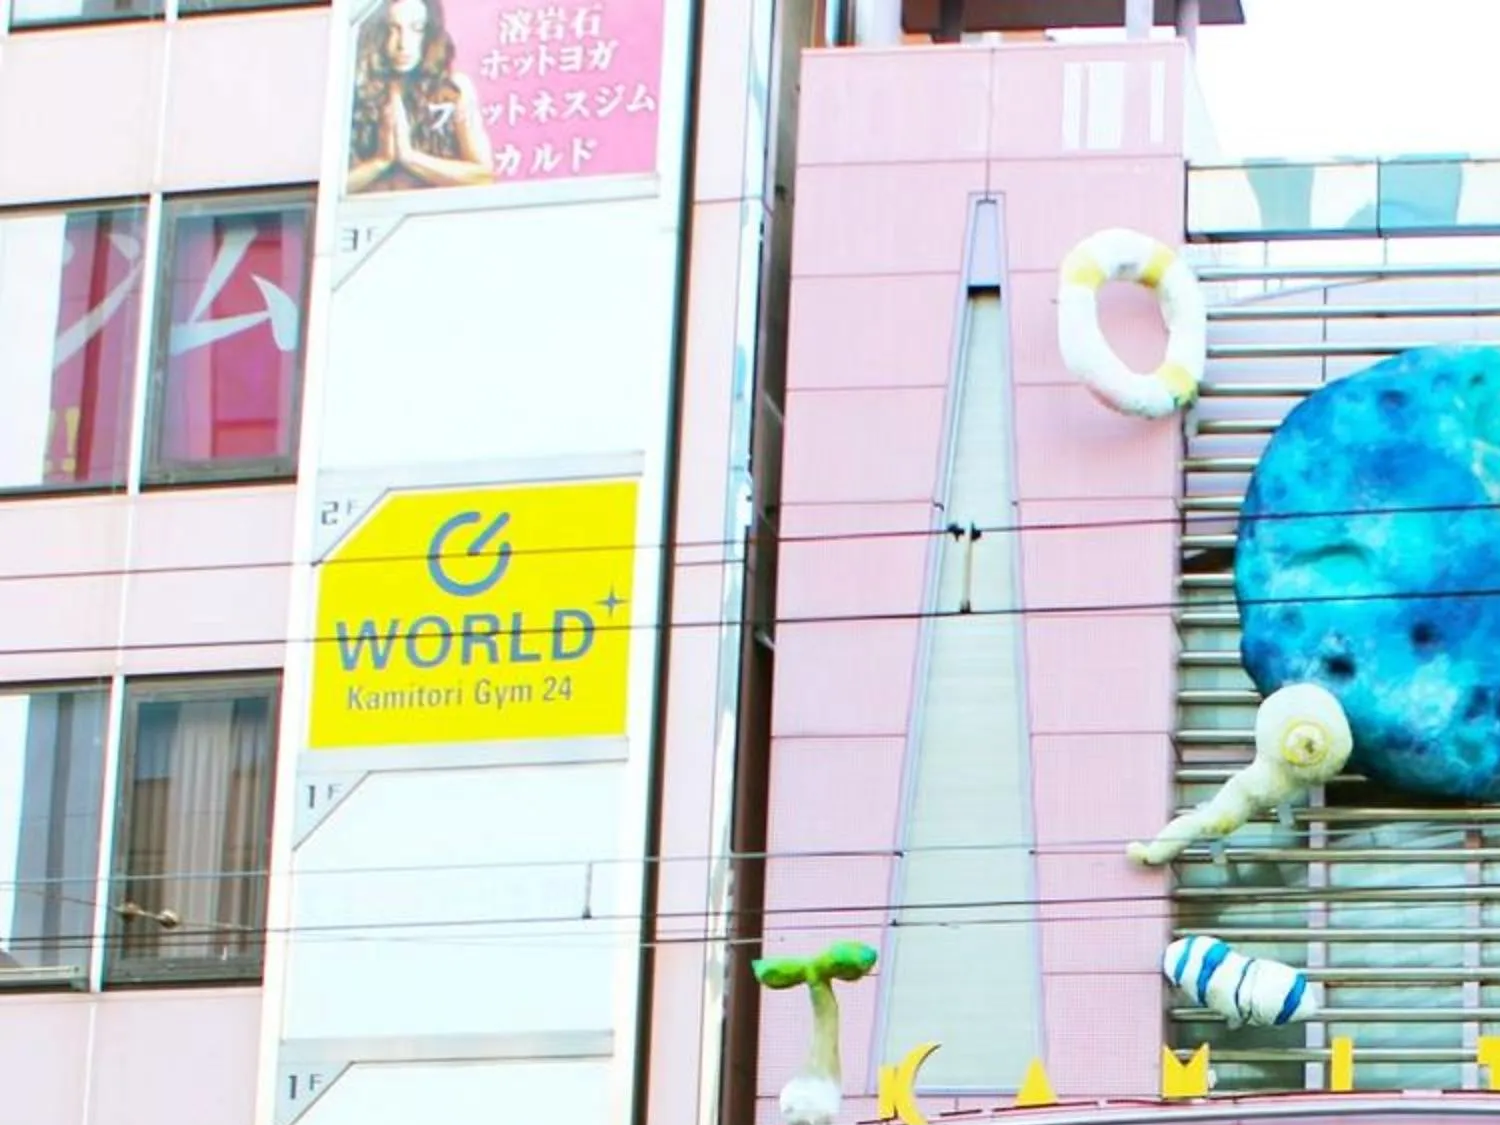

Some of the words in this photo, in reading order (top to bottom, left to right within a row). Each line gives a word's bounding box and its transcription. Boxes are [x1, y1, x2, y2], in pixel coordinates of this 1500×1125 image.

[499, 6, 602, 46] 溶岩石
[480, 40, 620, 80] ホットヨガ
[428, 82, 658, 132] フットネスジム
[493, 137, 597, 177] カルド
[336, 607, 597, 672] WORLD
[347, 680, 464, 711] Kamitori
[473, 678, 533, 711] Gym
[542, 675, 573, 702] 24
